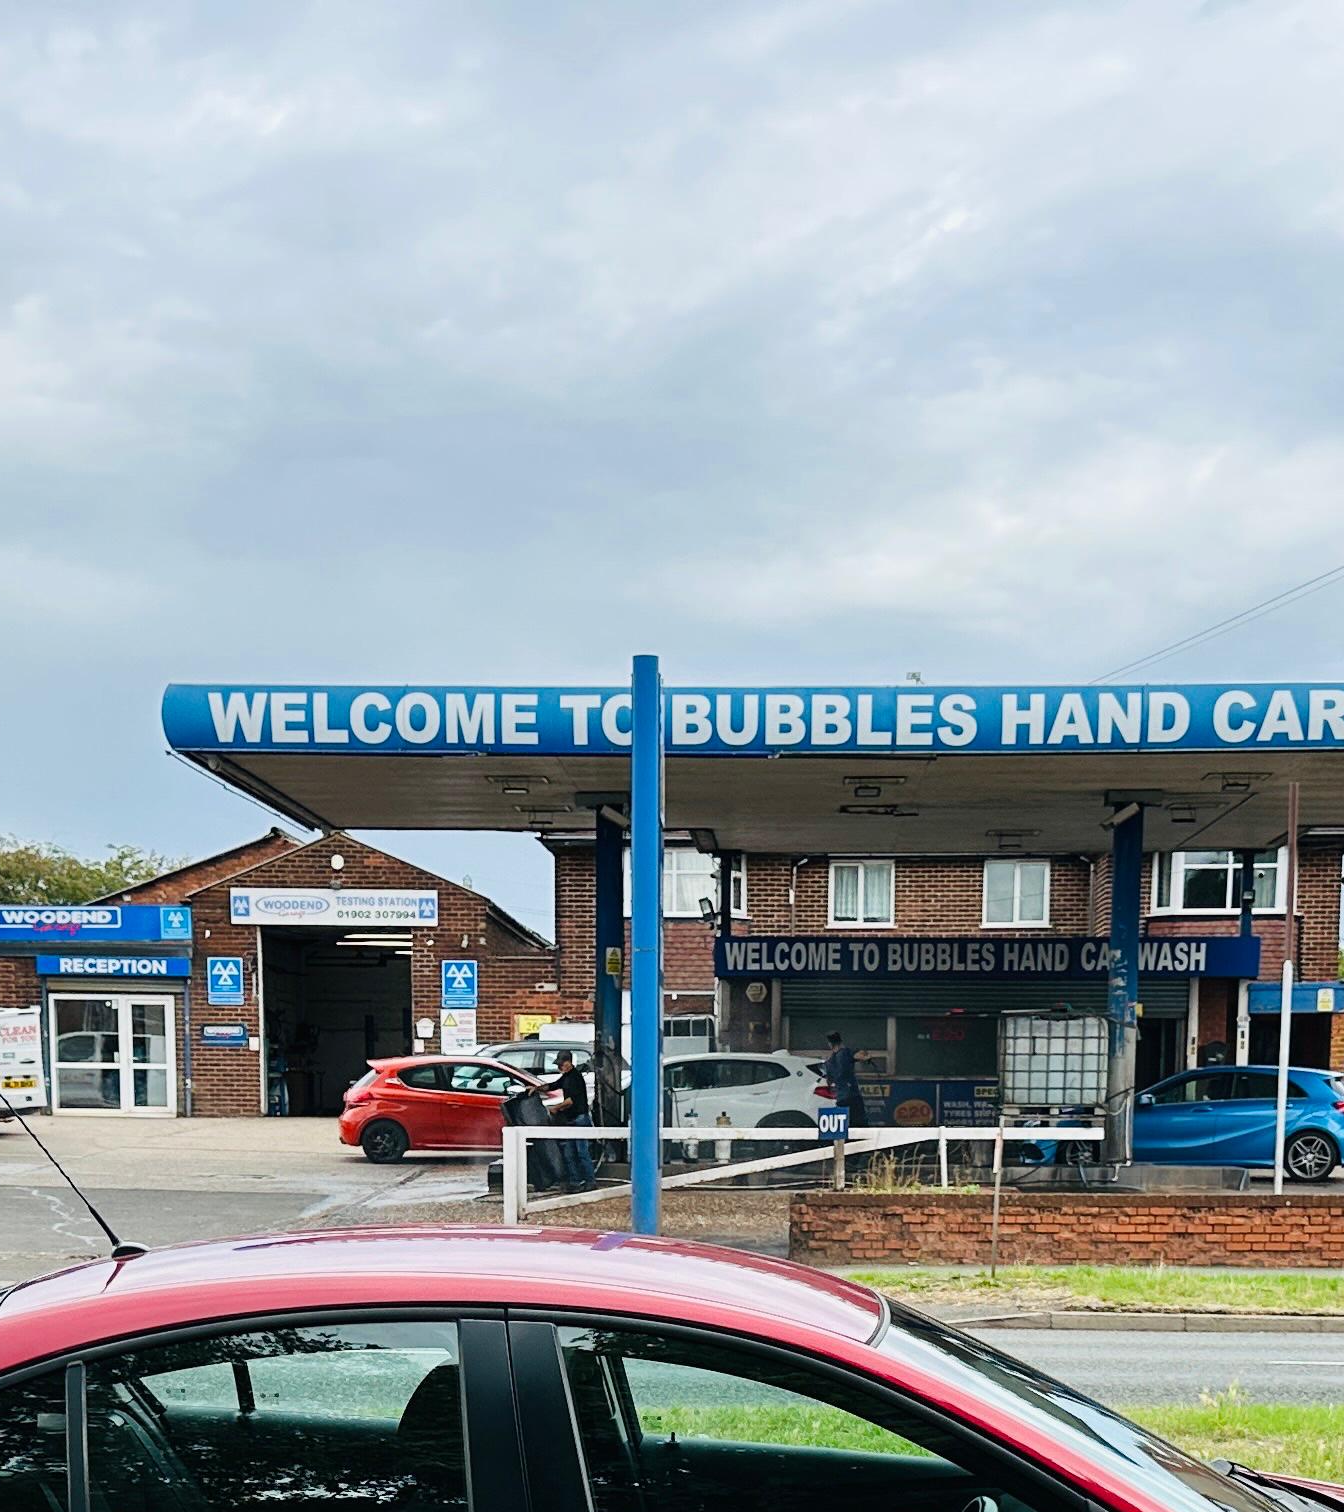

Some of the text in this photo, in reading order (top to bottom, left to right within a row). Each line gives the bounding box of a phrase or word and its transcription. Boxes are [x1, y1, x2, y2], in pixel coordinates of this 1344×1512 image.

[208, 693, 539, 745] WELCOME
[560, 693, 633, 746] TO
[672, 692, 977, 746] BUBBLES
[1001, 691, 1206, 745] HAND
[264, 900, 323, 910] WOODEND
[336, 896, 417, 907] TESTING STATION
[2, 910, 112, 924] WOODEND
[337, 910, 416, 919] 01902 307994
[724, 942, 842, 971] WELCOME
[849, 942, 881, 972] TO
[887, 942, 996, 972] BUBBLES
[1003, 943, 1070, 972] HAND
[1080, 942, 1115, 971] CA
[59, 957, 168, 975] RECEPTION
[819, 1114, 847, 1133] OUT
